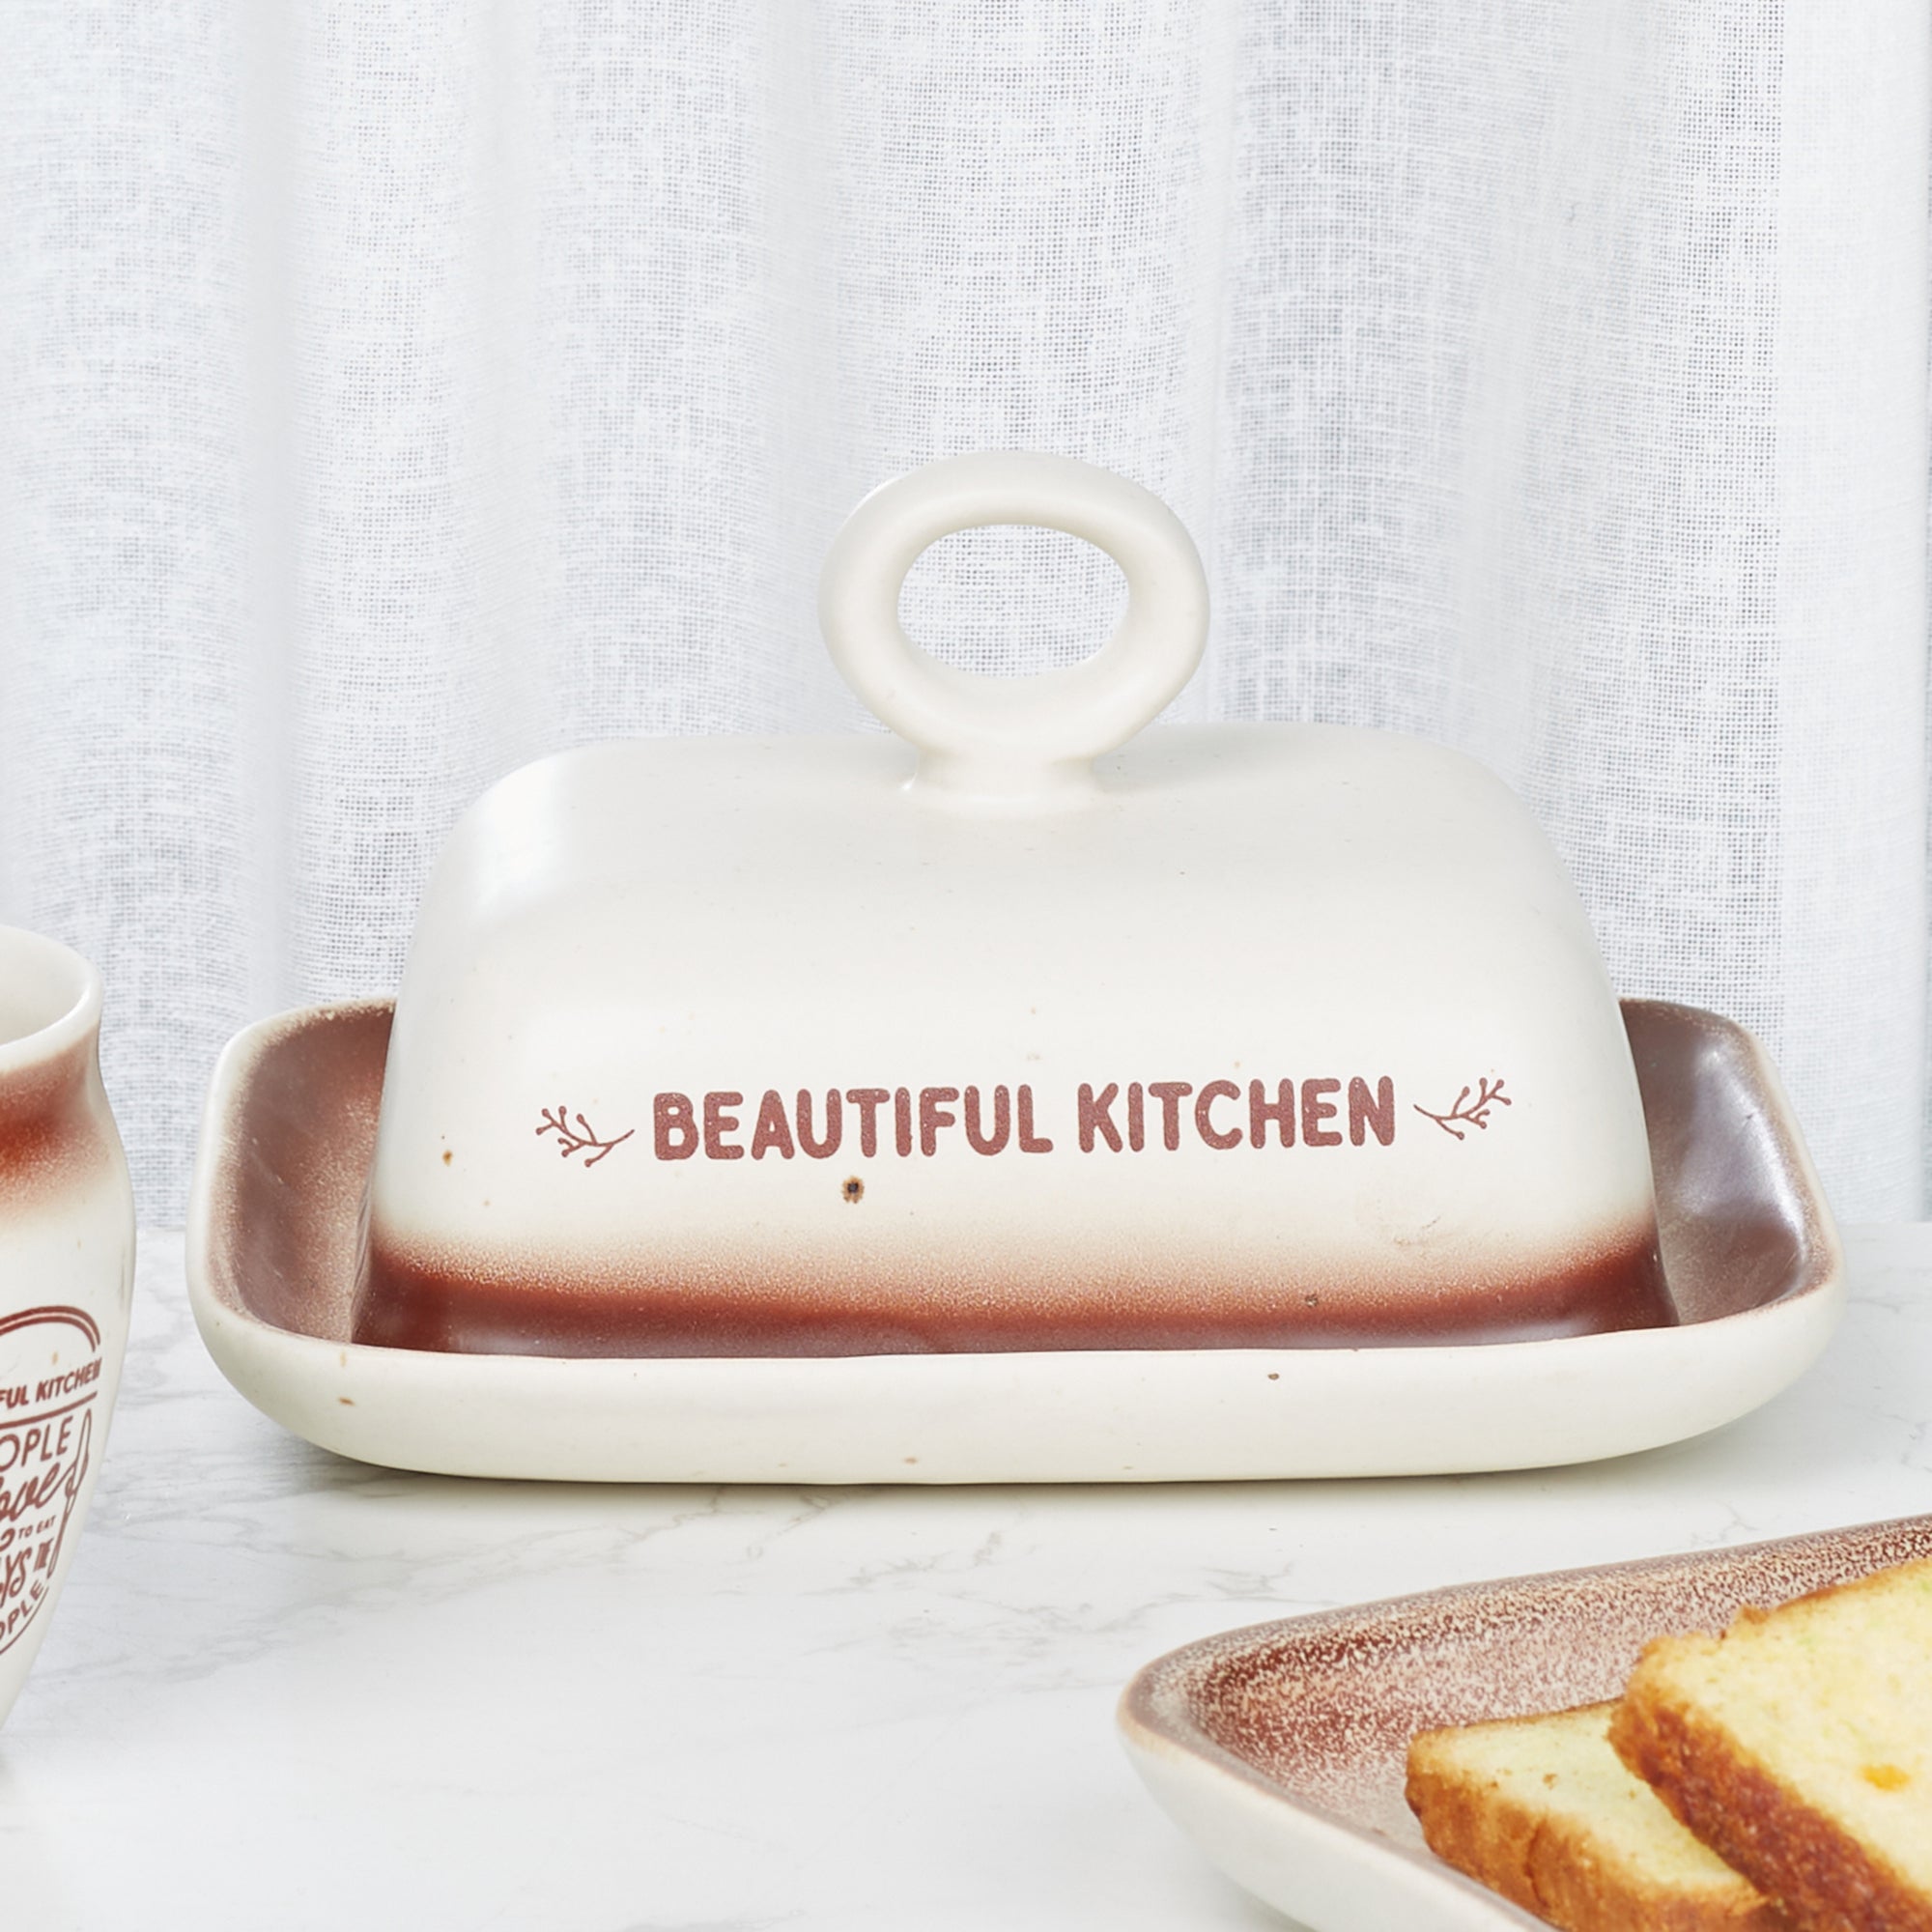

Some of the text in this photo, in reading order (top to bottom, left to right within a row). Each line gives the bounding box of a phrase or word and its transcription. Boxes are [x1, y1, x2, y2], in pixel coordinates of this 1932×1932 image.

[652, 1075, 1396, 1162] BEAUTIFUL KITCHEN
[36, 1356, 102, 1403] KITCHEN
